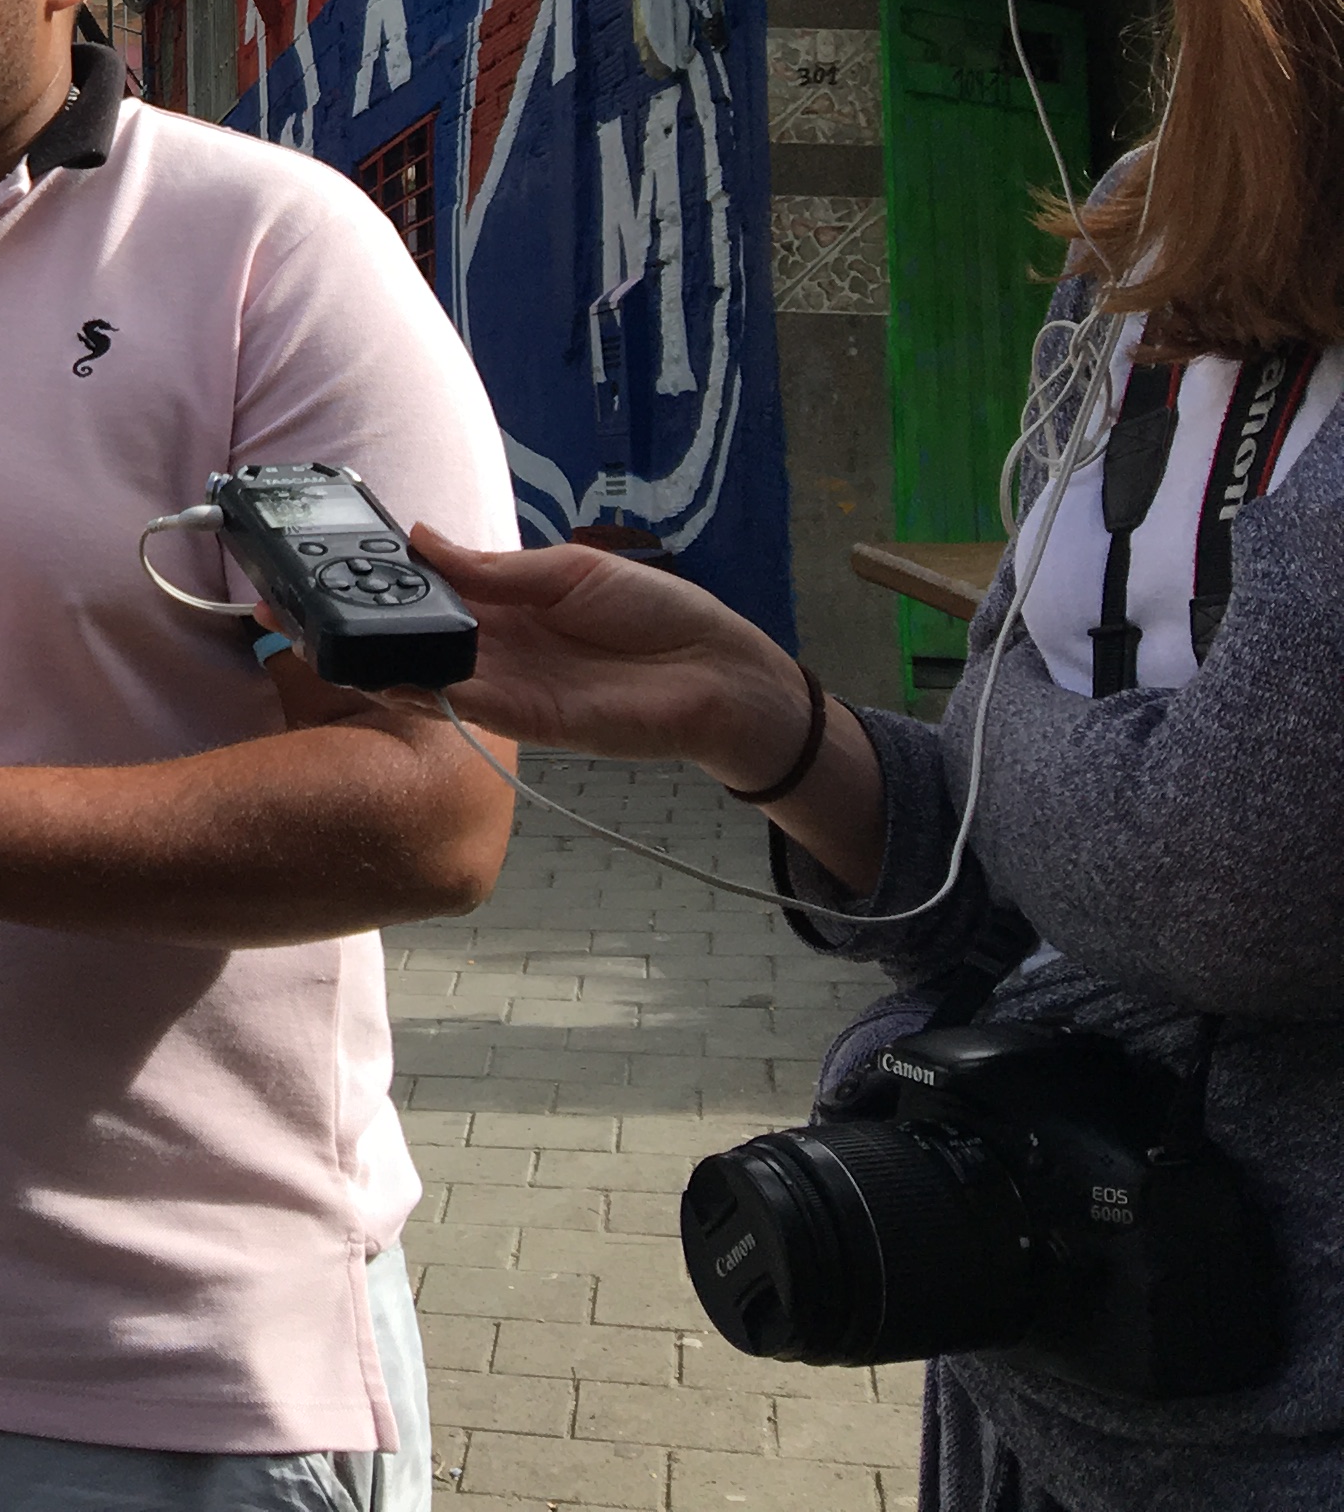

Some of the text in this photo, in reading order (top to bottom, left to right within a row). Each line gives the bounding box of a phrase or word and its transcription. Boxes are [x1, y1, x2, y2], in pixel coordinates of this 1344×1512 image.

[796, 66, 840, 87] 301
[882, 1053, 935, 1086] Canon
[1092, 1186, 1128, 1204] EOS
[1091, 1204, 1134, 1225] 600D
[716, 1233, 756, 1277] Canon
